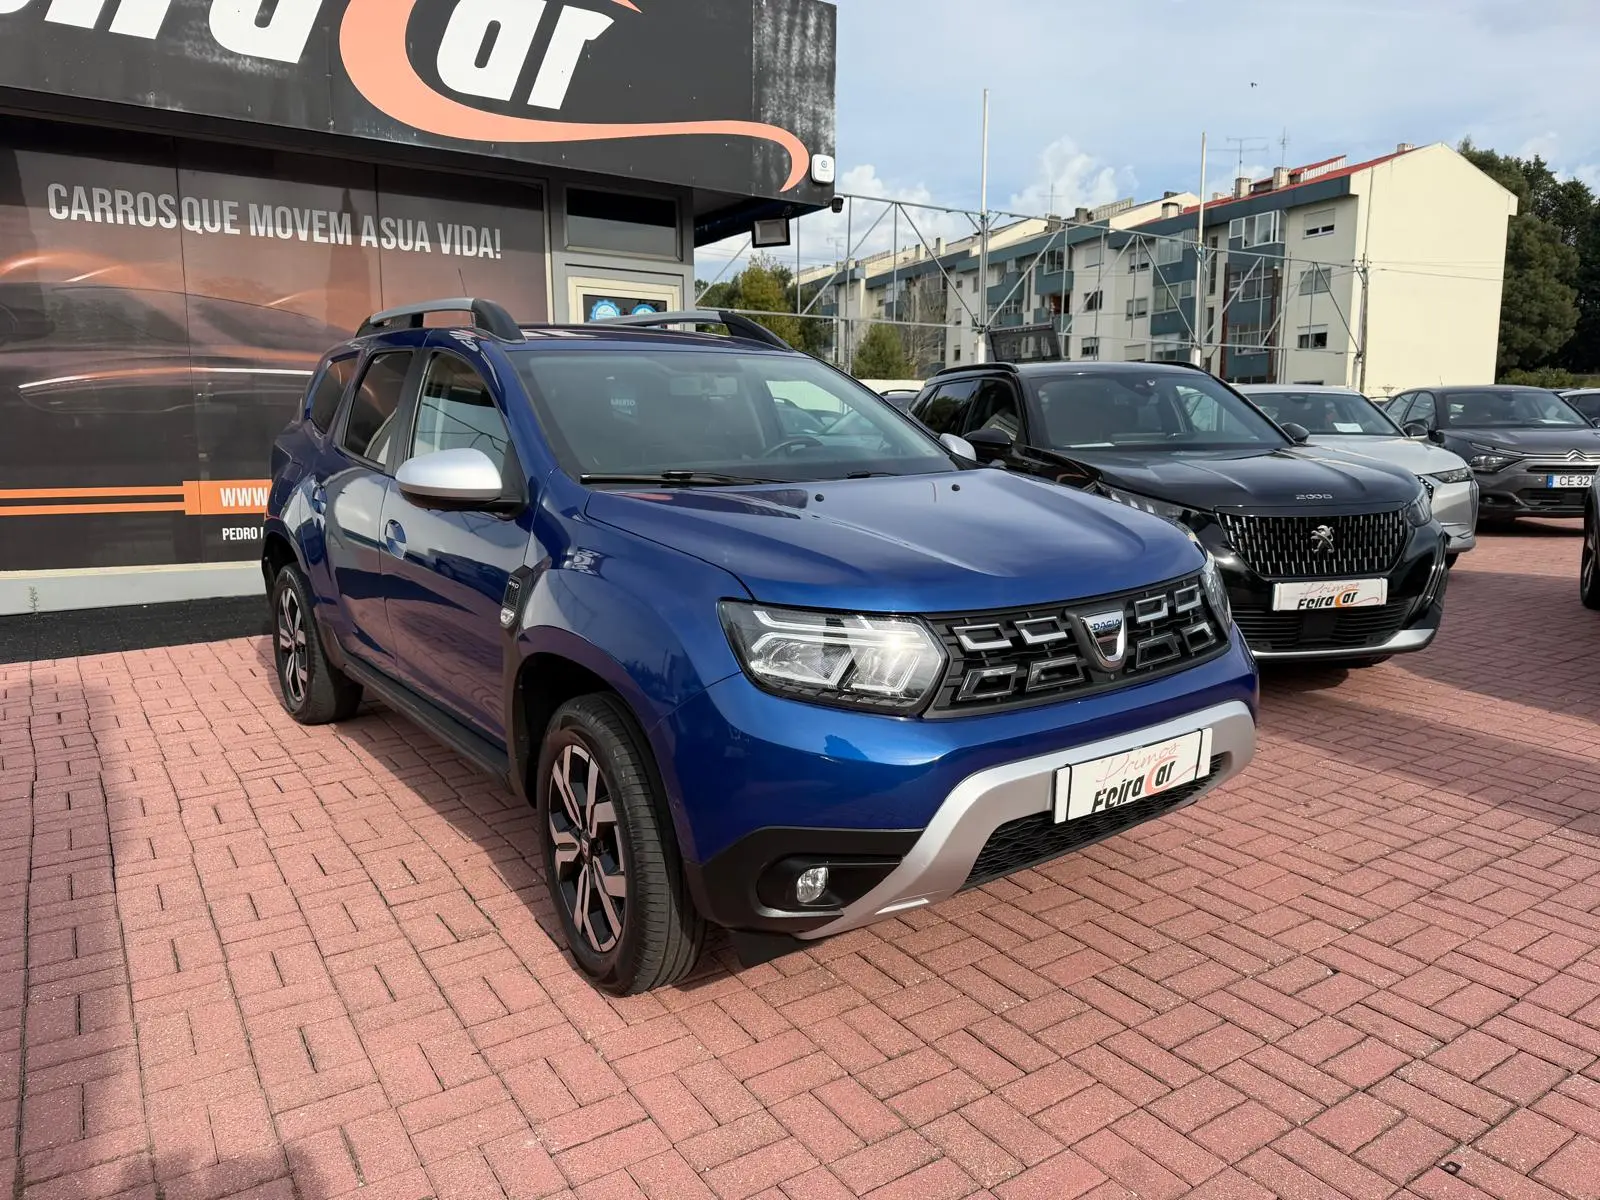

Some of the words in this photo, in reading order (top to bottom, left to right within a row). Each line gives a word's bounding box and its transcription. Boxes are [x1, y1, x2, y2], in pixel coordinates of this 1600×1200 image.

[47, 183, 177, 229] CARROS
[181, 197, 241, 234] QUE
[249, 203, 353, 246] MOVEM
[437, 222, 502, 260] VIDA!
[222, 527, 258, 541] PEDRO
[1093, 619, 1121, 630] DACIA
